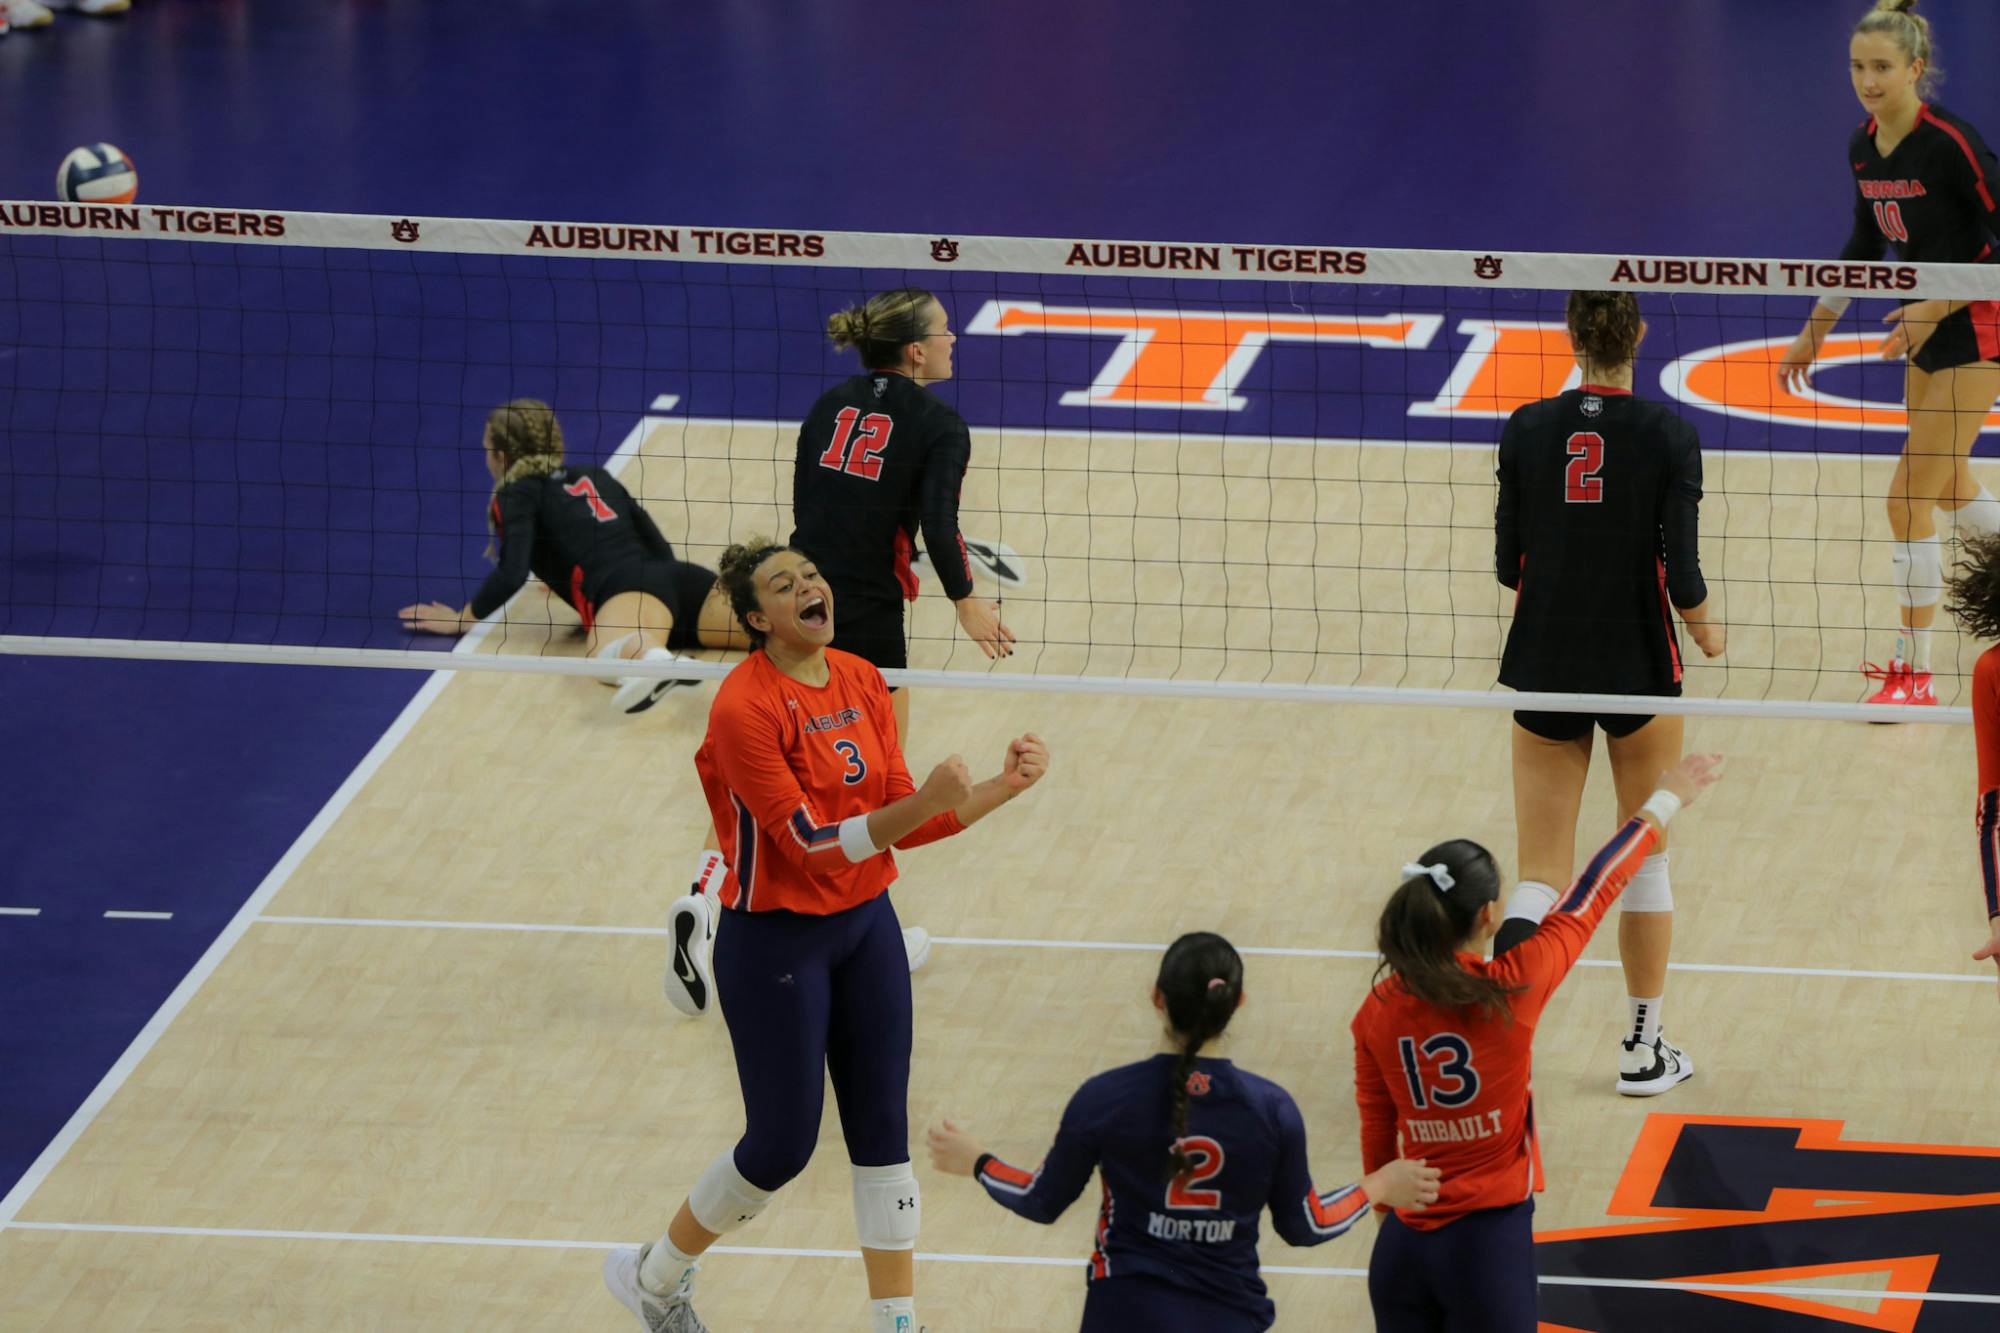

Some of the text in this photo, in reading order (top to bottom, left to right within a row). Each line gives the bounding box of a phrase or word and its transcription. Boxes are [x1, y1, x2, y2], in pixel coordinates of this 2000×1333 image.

[1858, 179, 1927, 199] EORGIA
[151, 208, 286, 238] TIGERS
[1873, 201, 1909, 242] 10
[525, 224, 826, 258] AUBURN TIGERS
[1065, 243, 1368, 275] AUBURN TIGERS
[1609, 258, 1918, 291] AUBURN TIGERS
[819, 405, 894, 482] 12
[1564, 431, 1605, 503] 2
[562, 475, 619, 523] 7
[833, 738, 867, 786] 3
[1397, 1031, 1481, 1109] 13
[1406, 1108, 1503, 1144] THIBAULT
[1165, 1135, 1225, 1211] 2
[1147, 1211, 1236, 1243] MORTON
